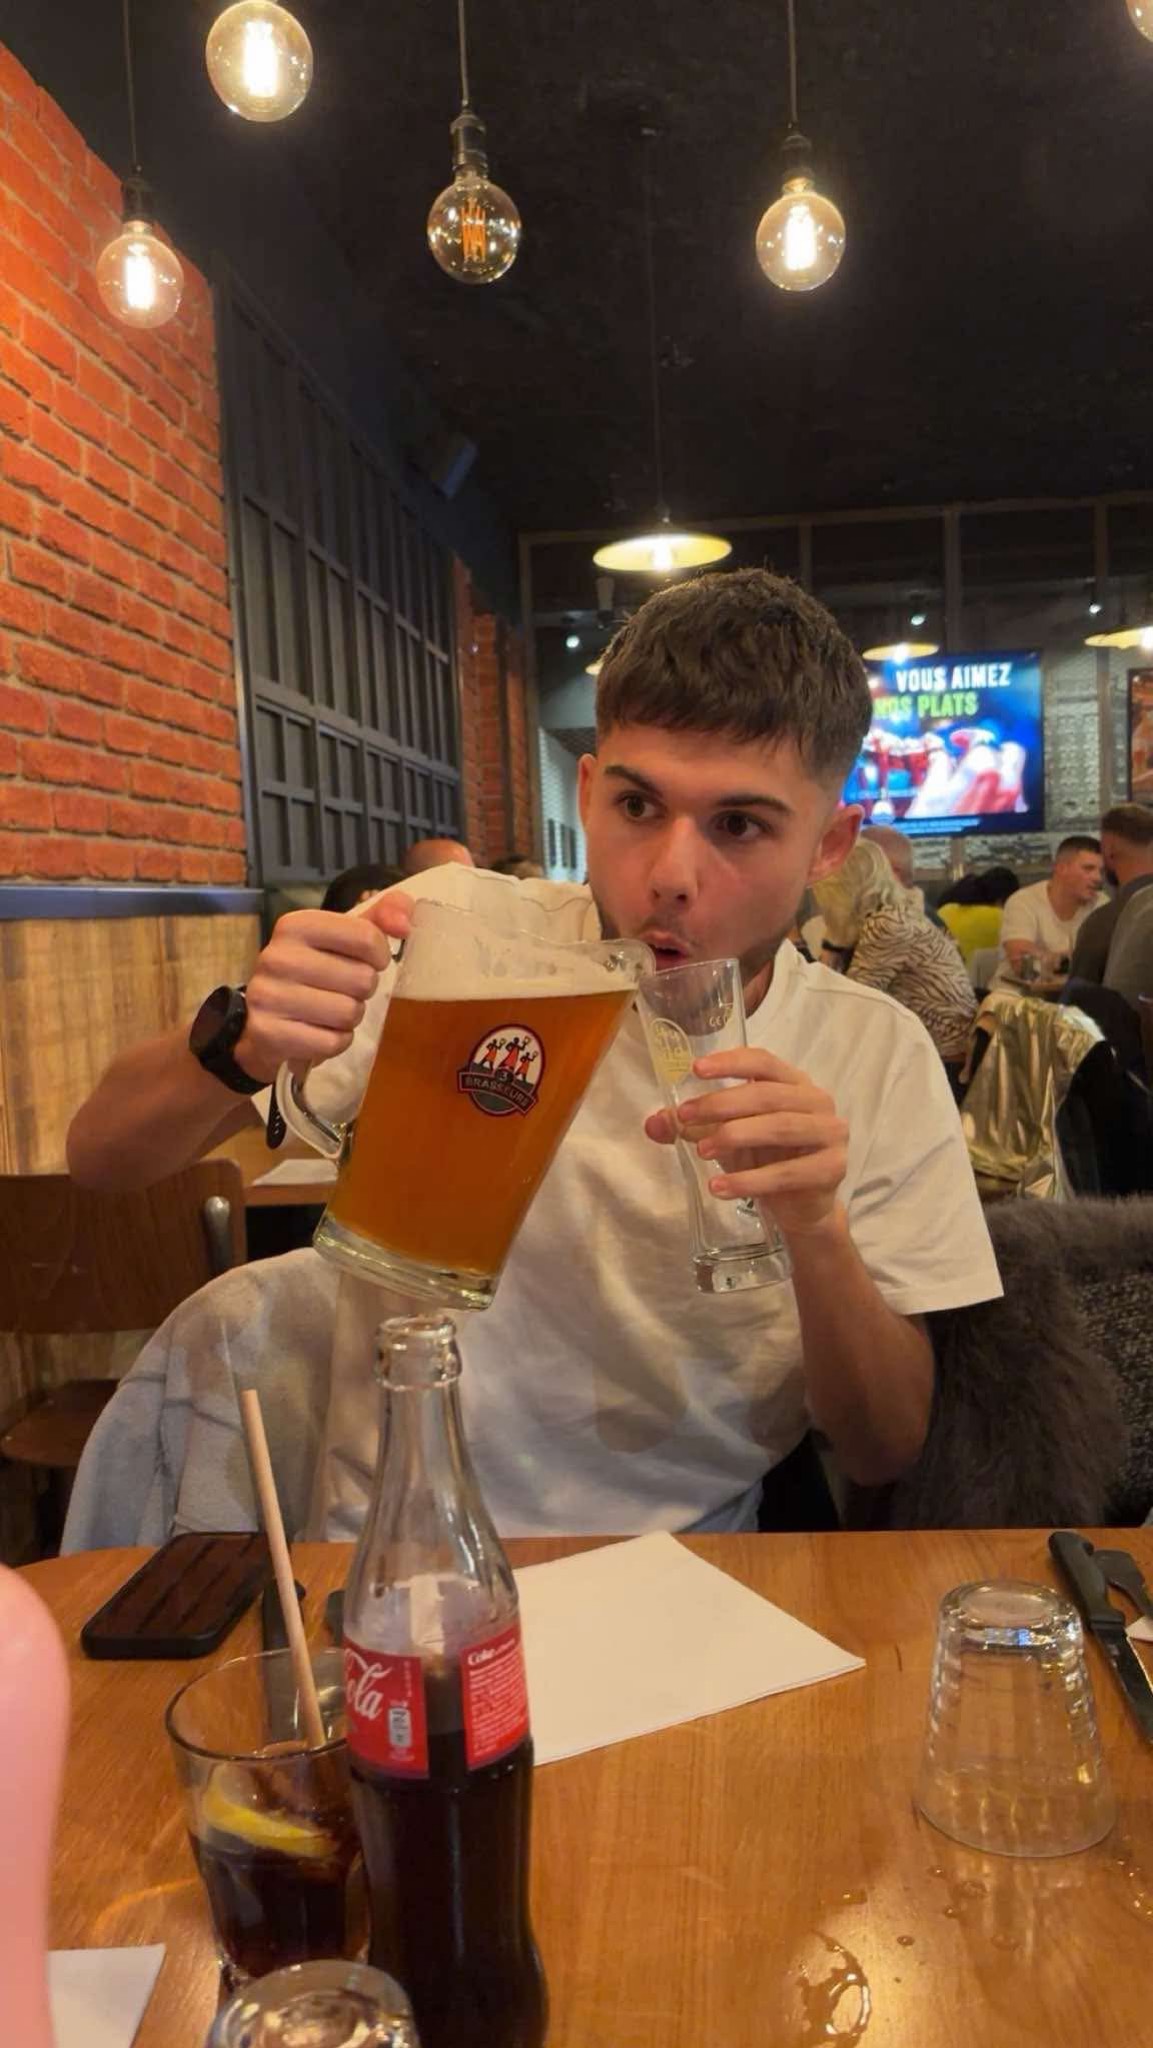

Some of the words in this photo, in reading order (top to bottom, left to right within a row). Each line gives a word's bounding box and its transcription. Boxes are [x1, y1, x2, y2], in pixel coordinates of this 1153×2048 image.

[896, 666, 946, 692] VOUS
[952, 662, 1012, 689] AIMEZ
[917, 691, 978, 718] PLATS
